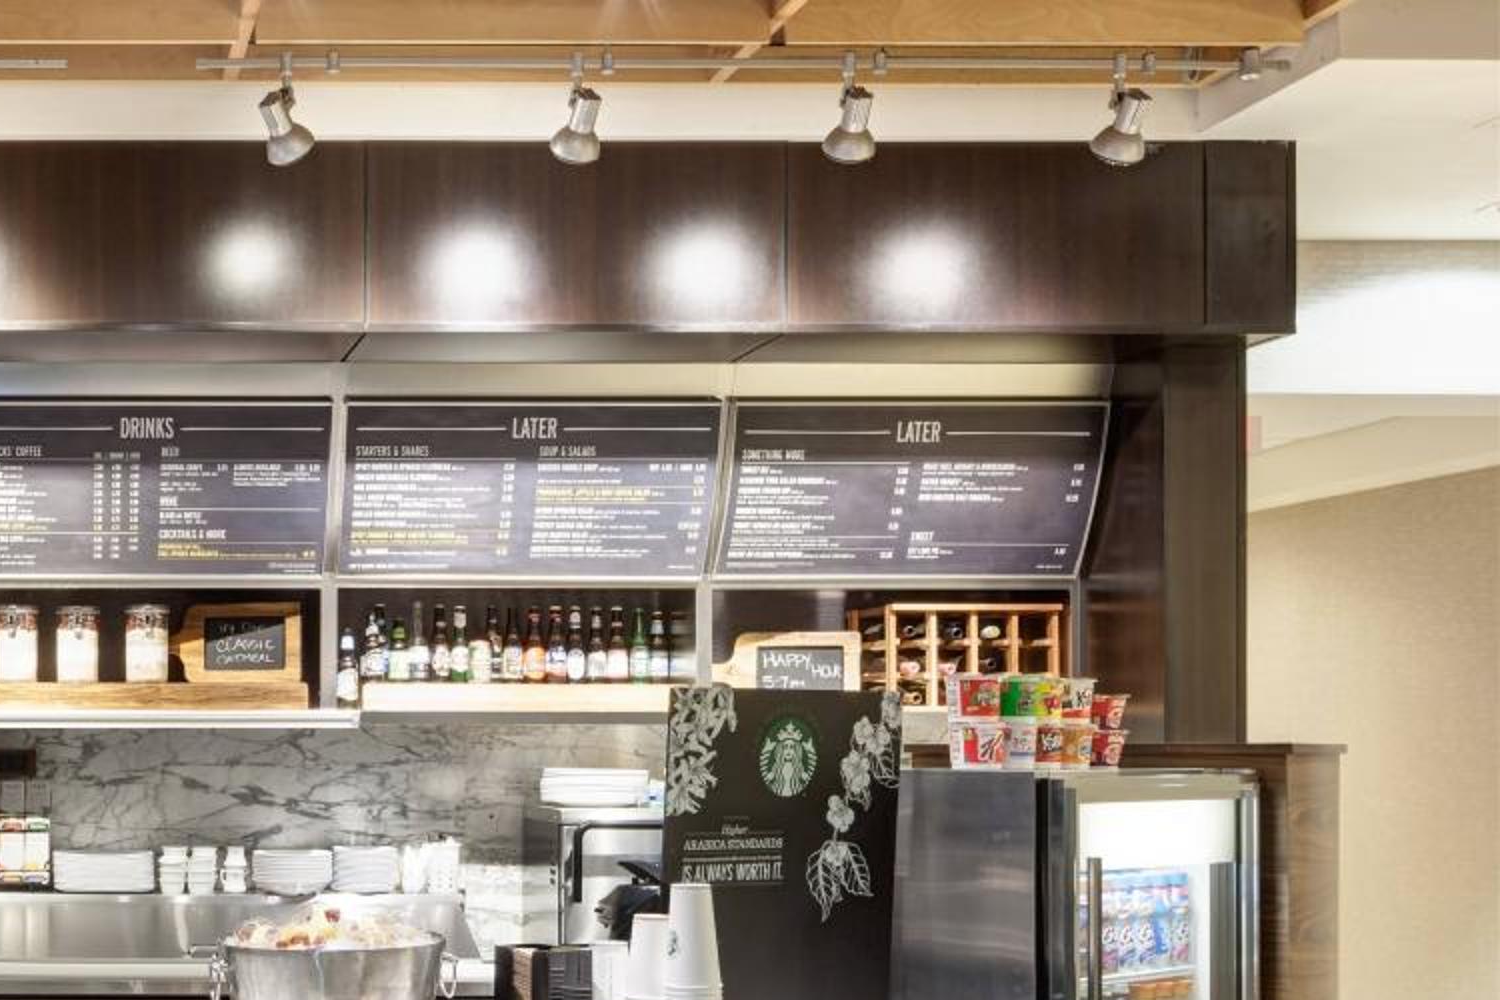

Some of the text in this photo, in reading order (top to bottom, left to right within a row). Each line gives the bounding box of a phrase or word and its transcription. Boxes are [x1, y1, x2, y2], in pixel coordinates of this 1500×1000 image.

[119, 417, 174, 439] DRINKS
[512, 417, 557, 439] LATER
[896, 421, 941, 443] LATER
[15, 445, 42, 457] COFFEE
[355, 445, 391, 457] STARTERS
[762, 650, 812, 670] HAPPY
[681, 865, 694, 883] IS
[694, 863, 734, 882] ALWAYS
[736, 862, 771, 881] WORTH
